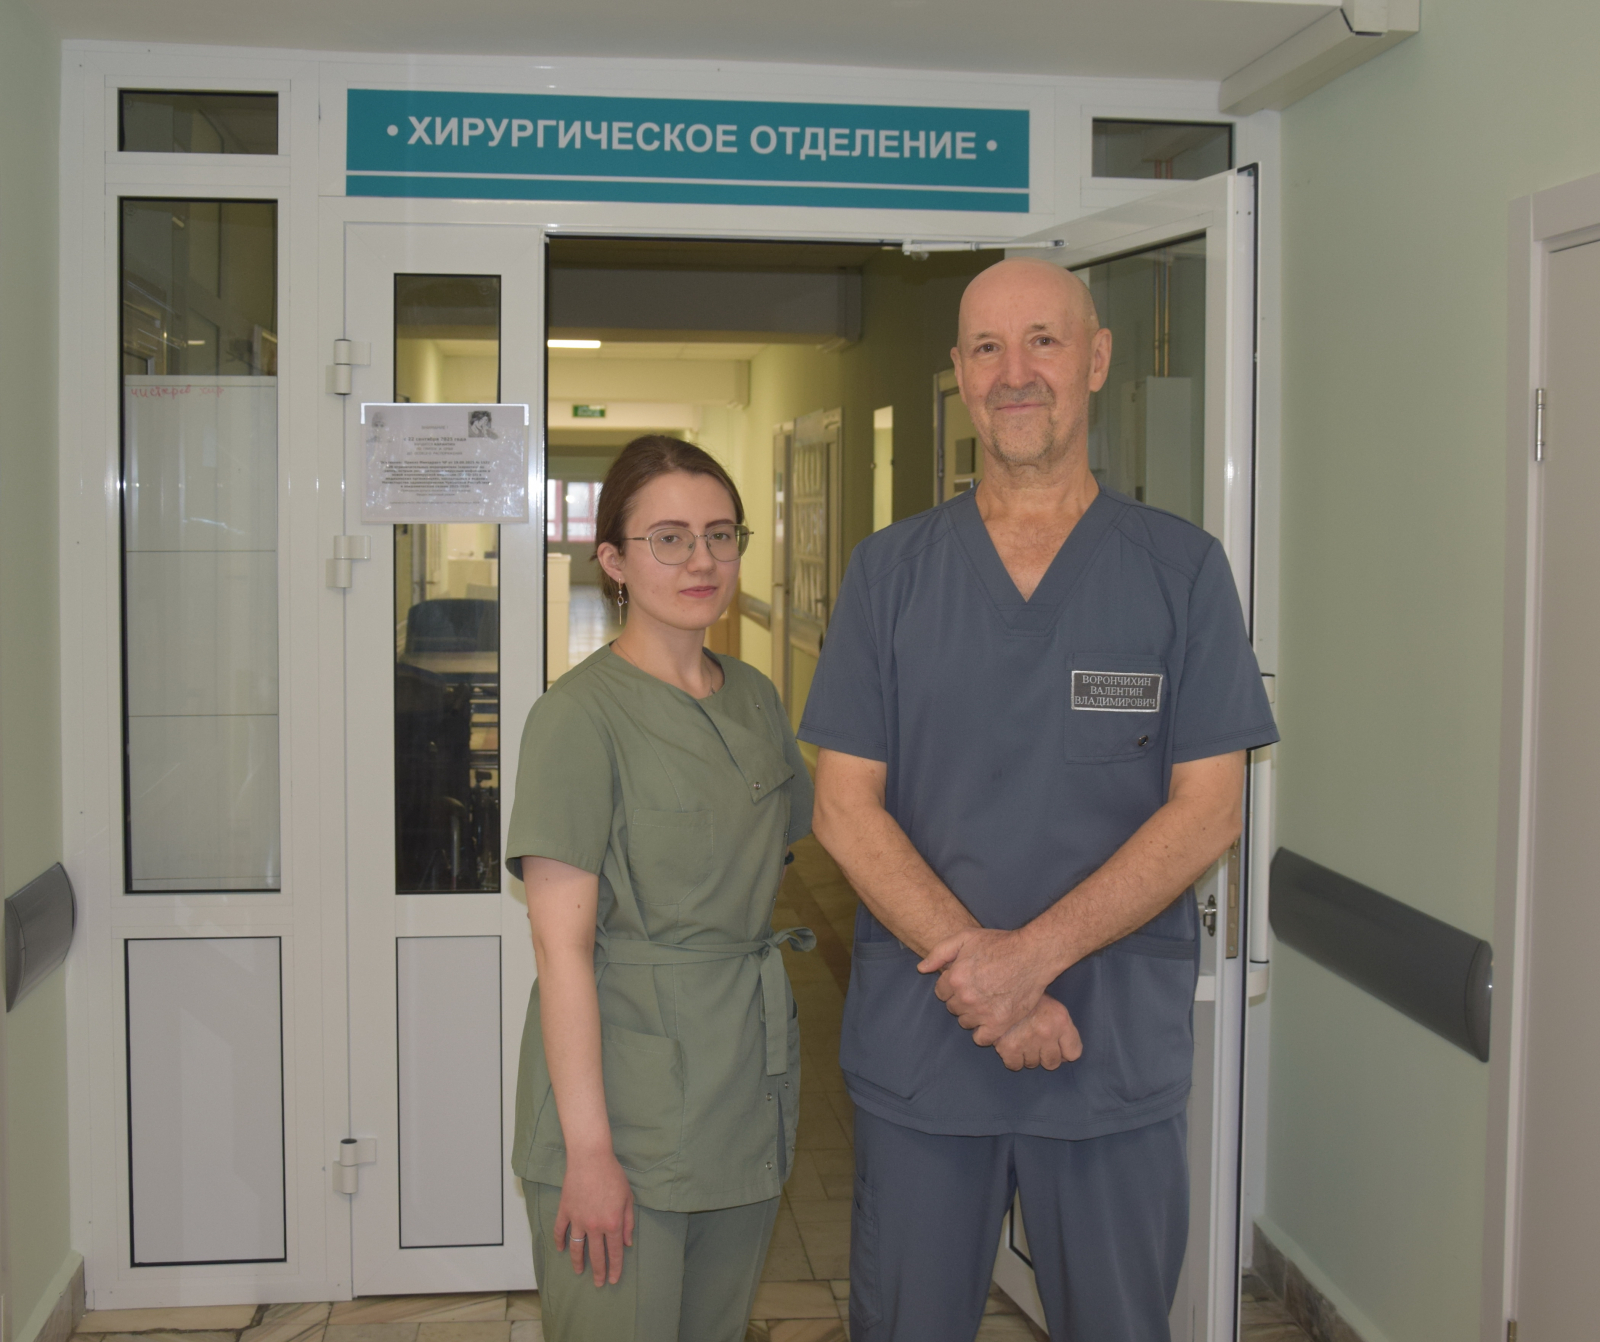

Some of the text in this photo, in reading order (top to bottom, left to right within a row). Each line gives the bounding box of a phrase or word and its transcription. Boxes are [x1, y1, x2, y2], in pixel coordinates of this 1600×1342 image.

[406, 115, 978, 161] ХИРУРГИЧЕСКОЕ ОТДЕЛЕНИЕ
[1082, 675, 1151, 686] ВОРОНЧИХИН
[1090, 686, 1143, 697] ВАЛЕНТИН
[1074, 696, 1156, 707] ВЛАДИМИРОВИЧ
